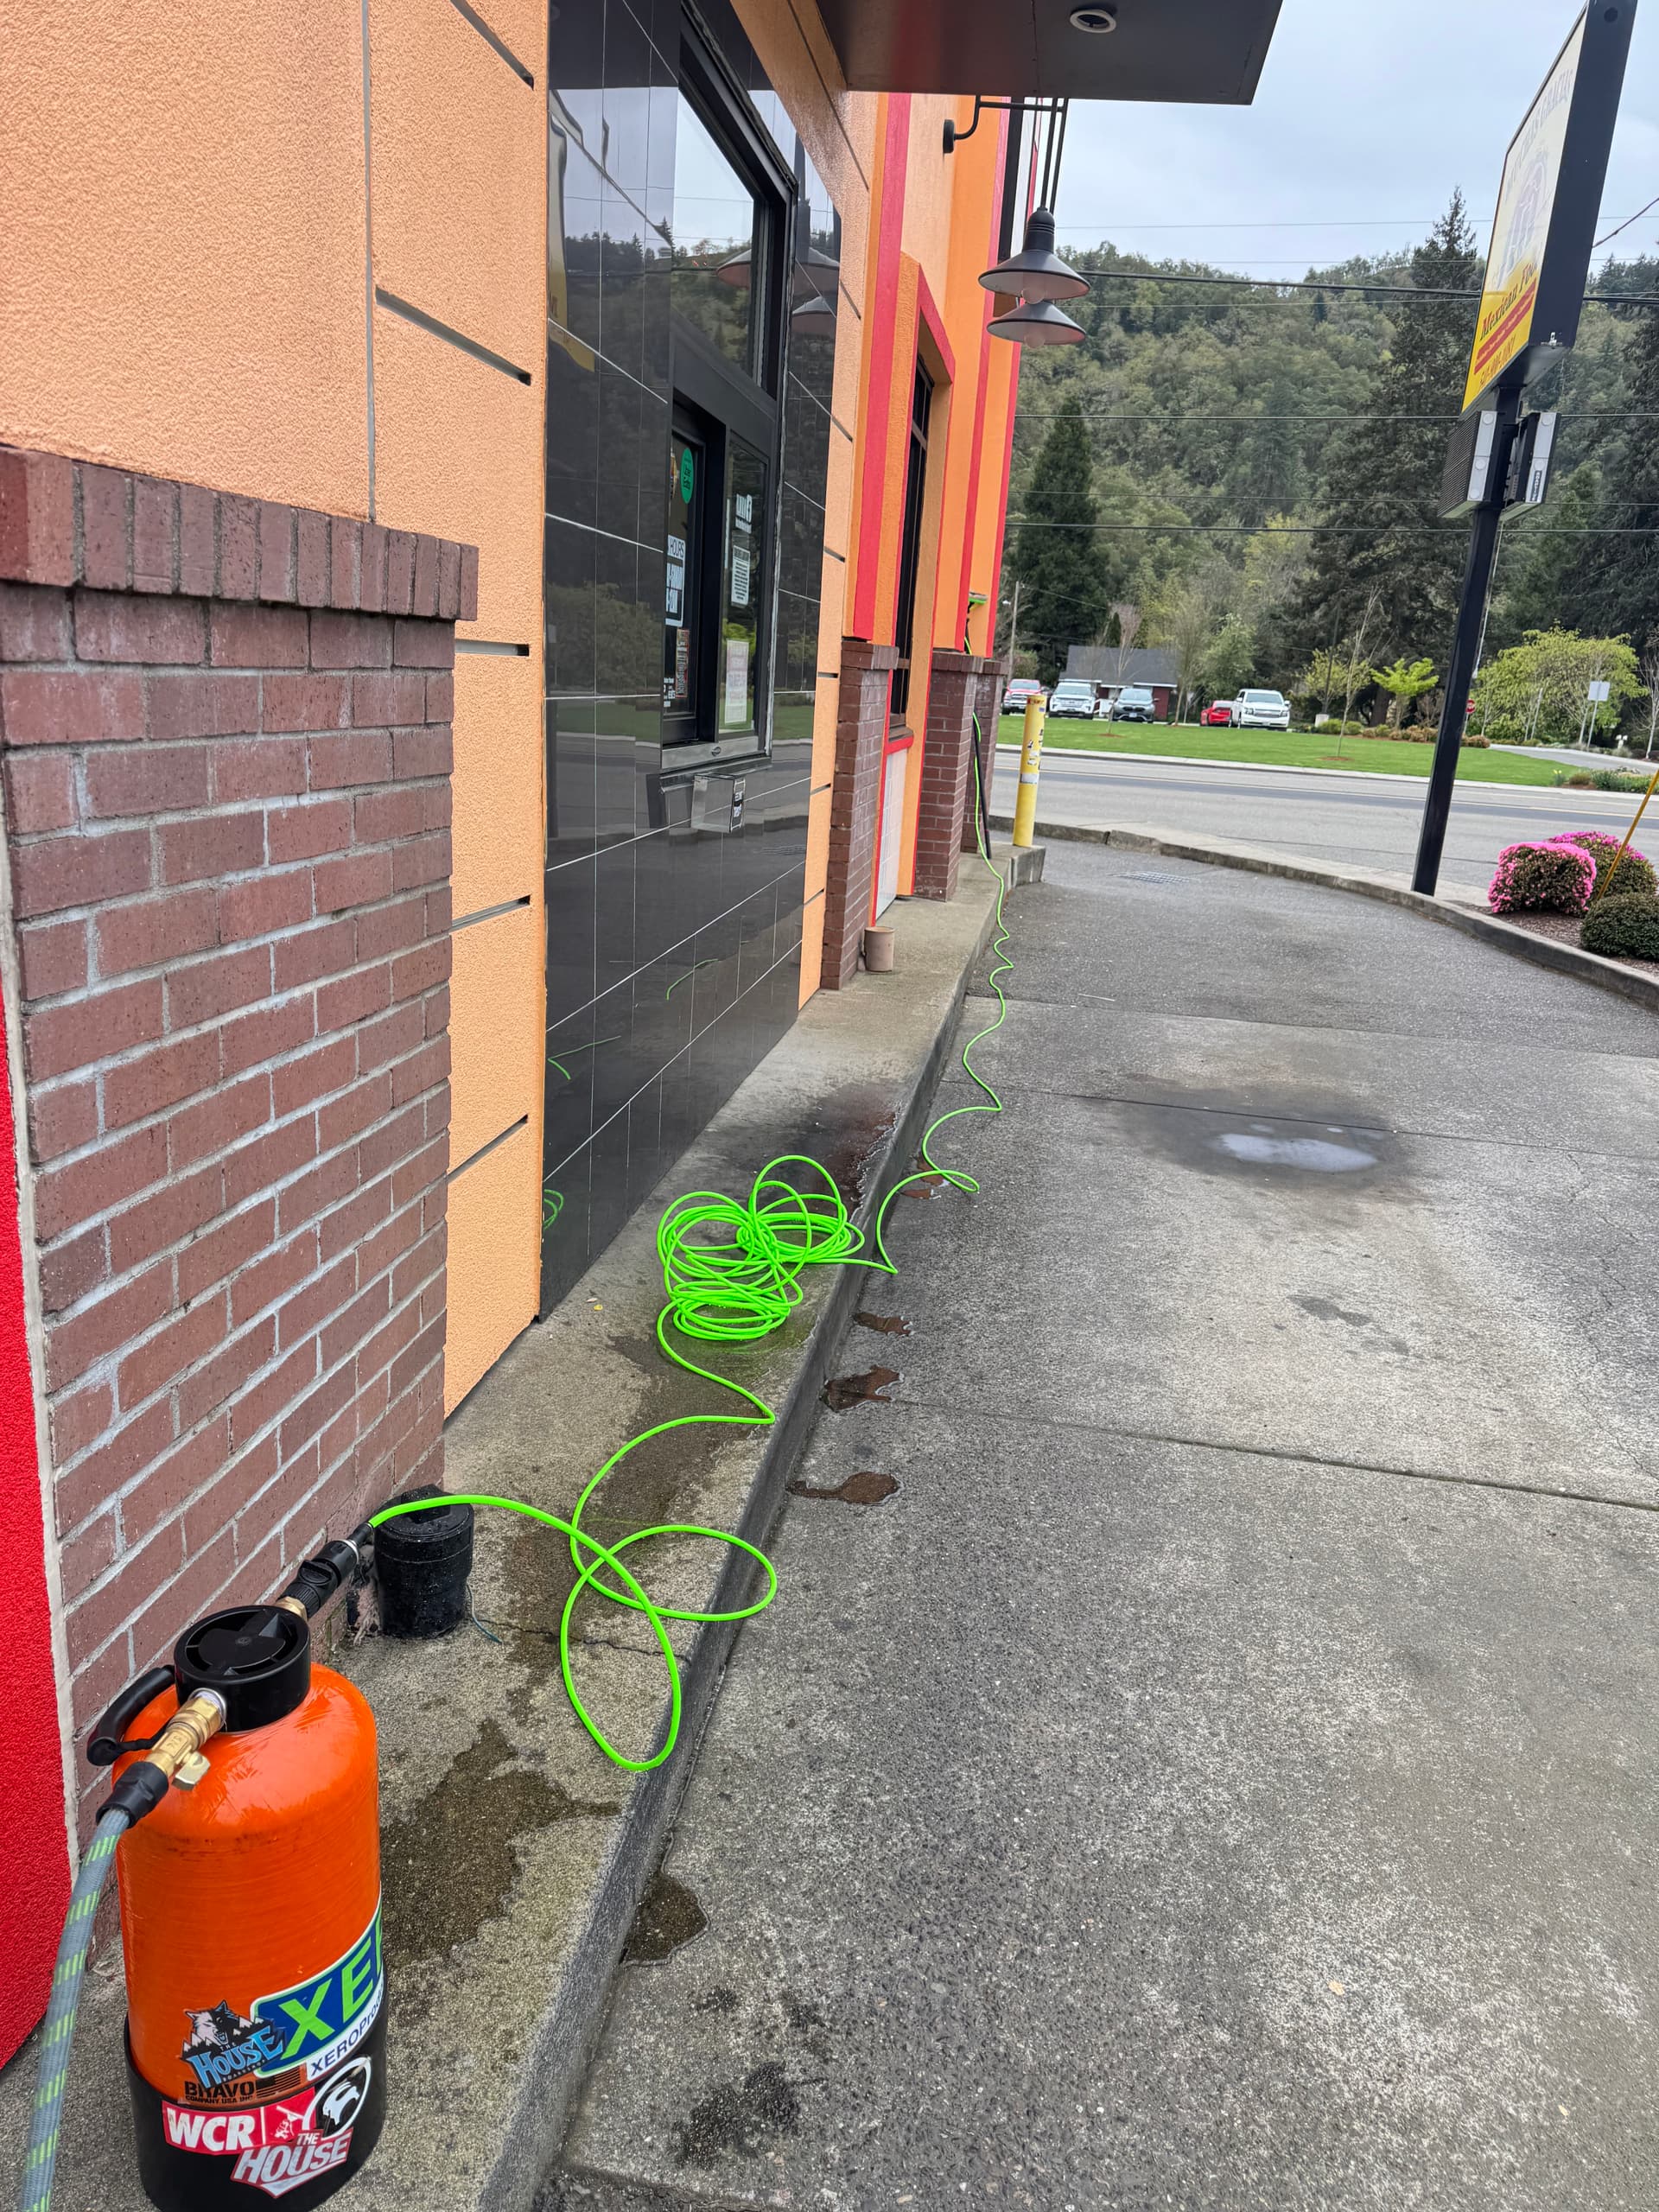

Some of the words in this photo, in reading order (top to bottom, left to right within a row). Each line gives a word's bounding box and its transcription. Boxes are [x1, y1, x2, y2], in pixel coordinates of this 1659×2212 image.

[1479, 283, 1518, 341] Mexican
[185, 2095, 219, 2104] COMPANY
[166, 2107, 256, 2152] WCR
[296, 2132, 321, 2145] THE
[232, 2132, 352, 2183] HOUSE
